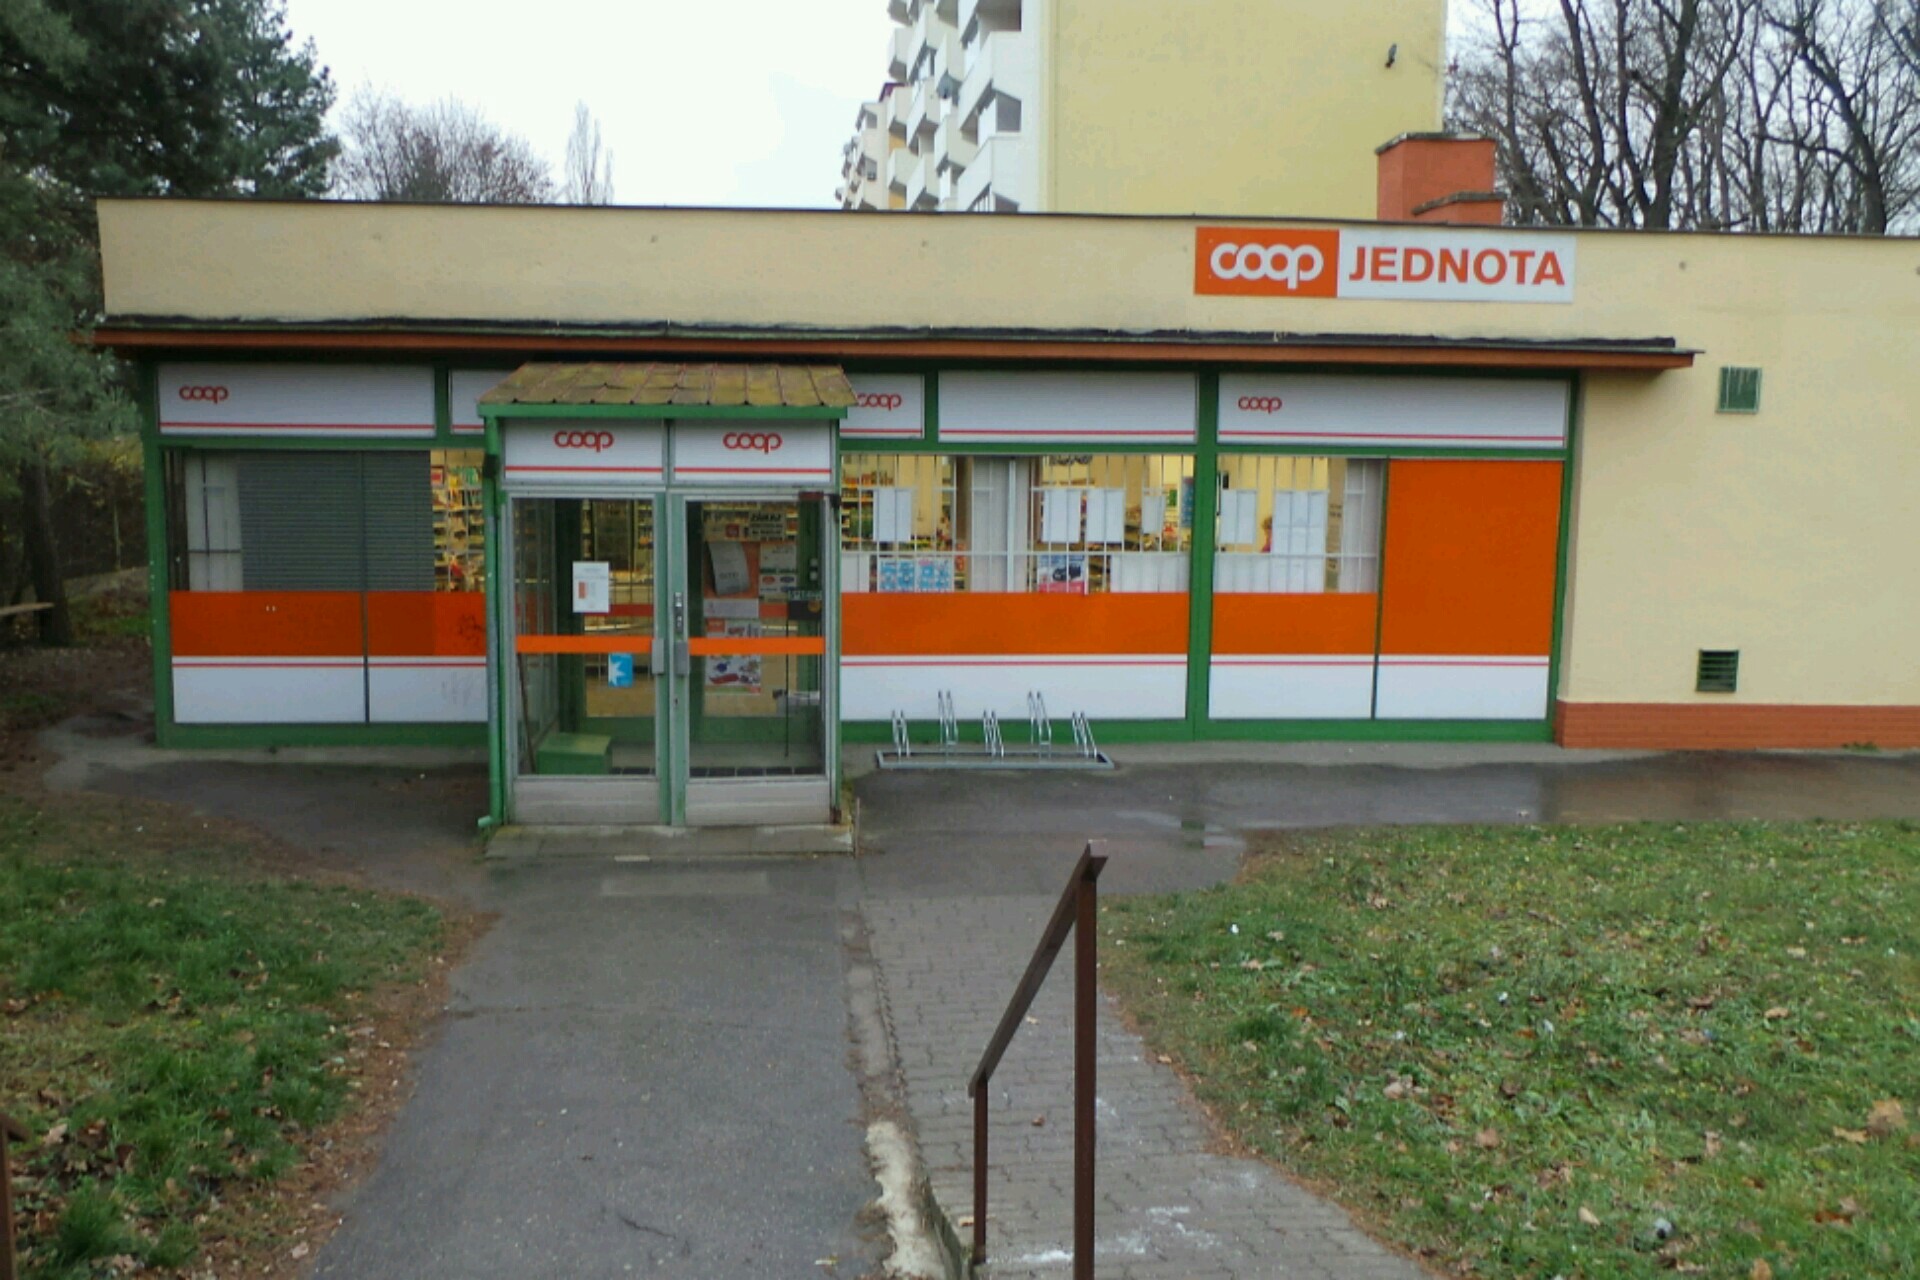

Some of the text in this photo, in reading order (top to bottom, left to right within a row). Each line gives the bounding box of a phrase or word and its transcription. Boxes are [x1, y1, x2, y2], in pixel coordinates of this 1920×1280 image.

[1210, 243, 1565, 289] coop JEDNOTA
[179, 386, 229, 403] coop
[1238, 397, 1282, 414] coop
[554, 431, 614, 453] coop
[723, 432, 782, 454] coop
